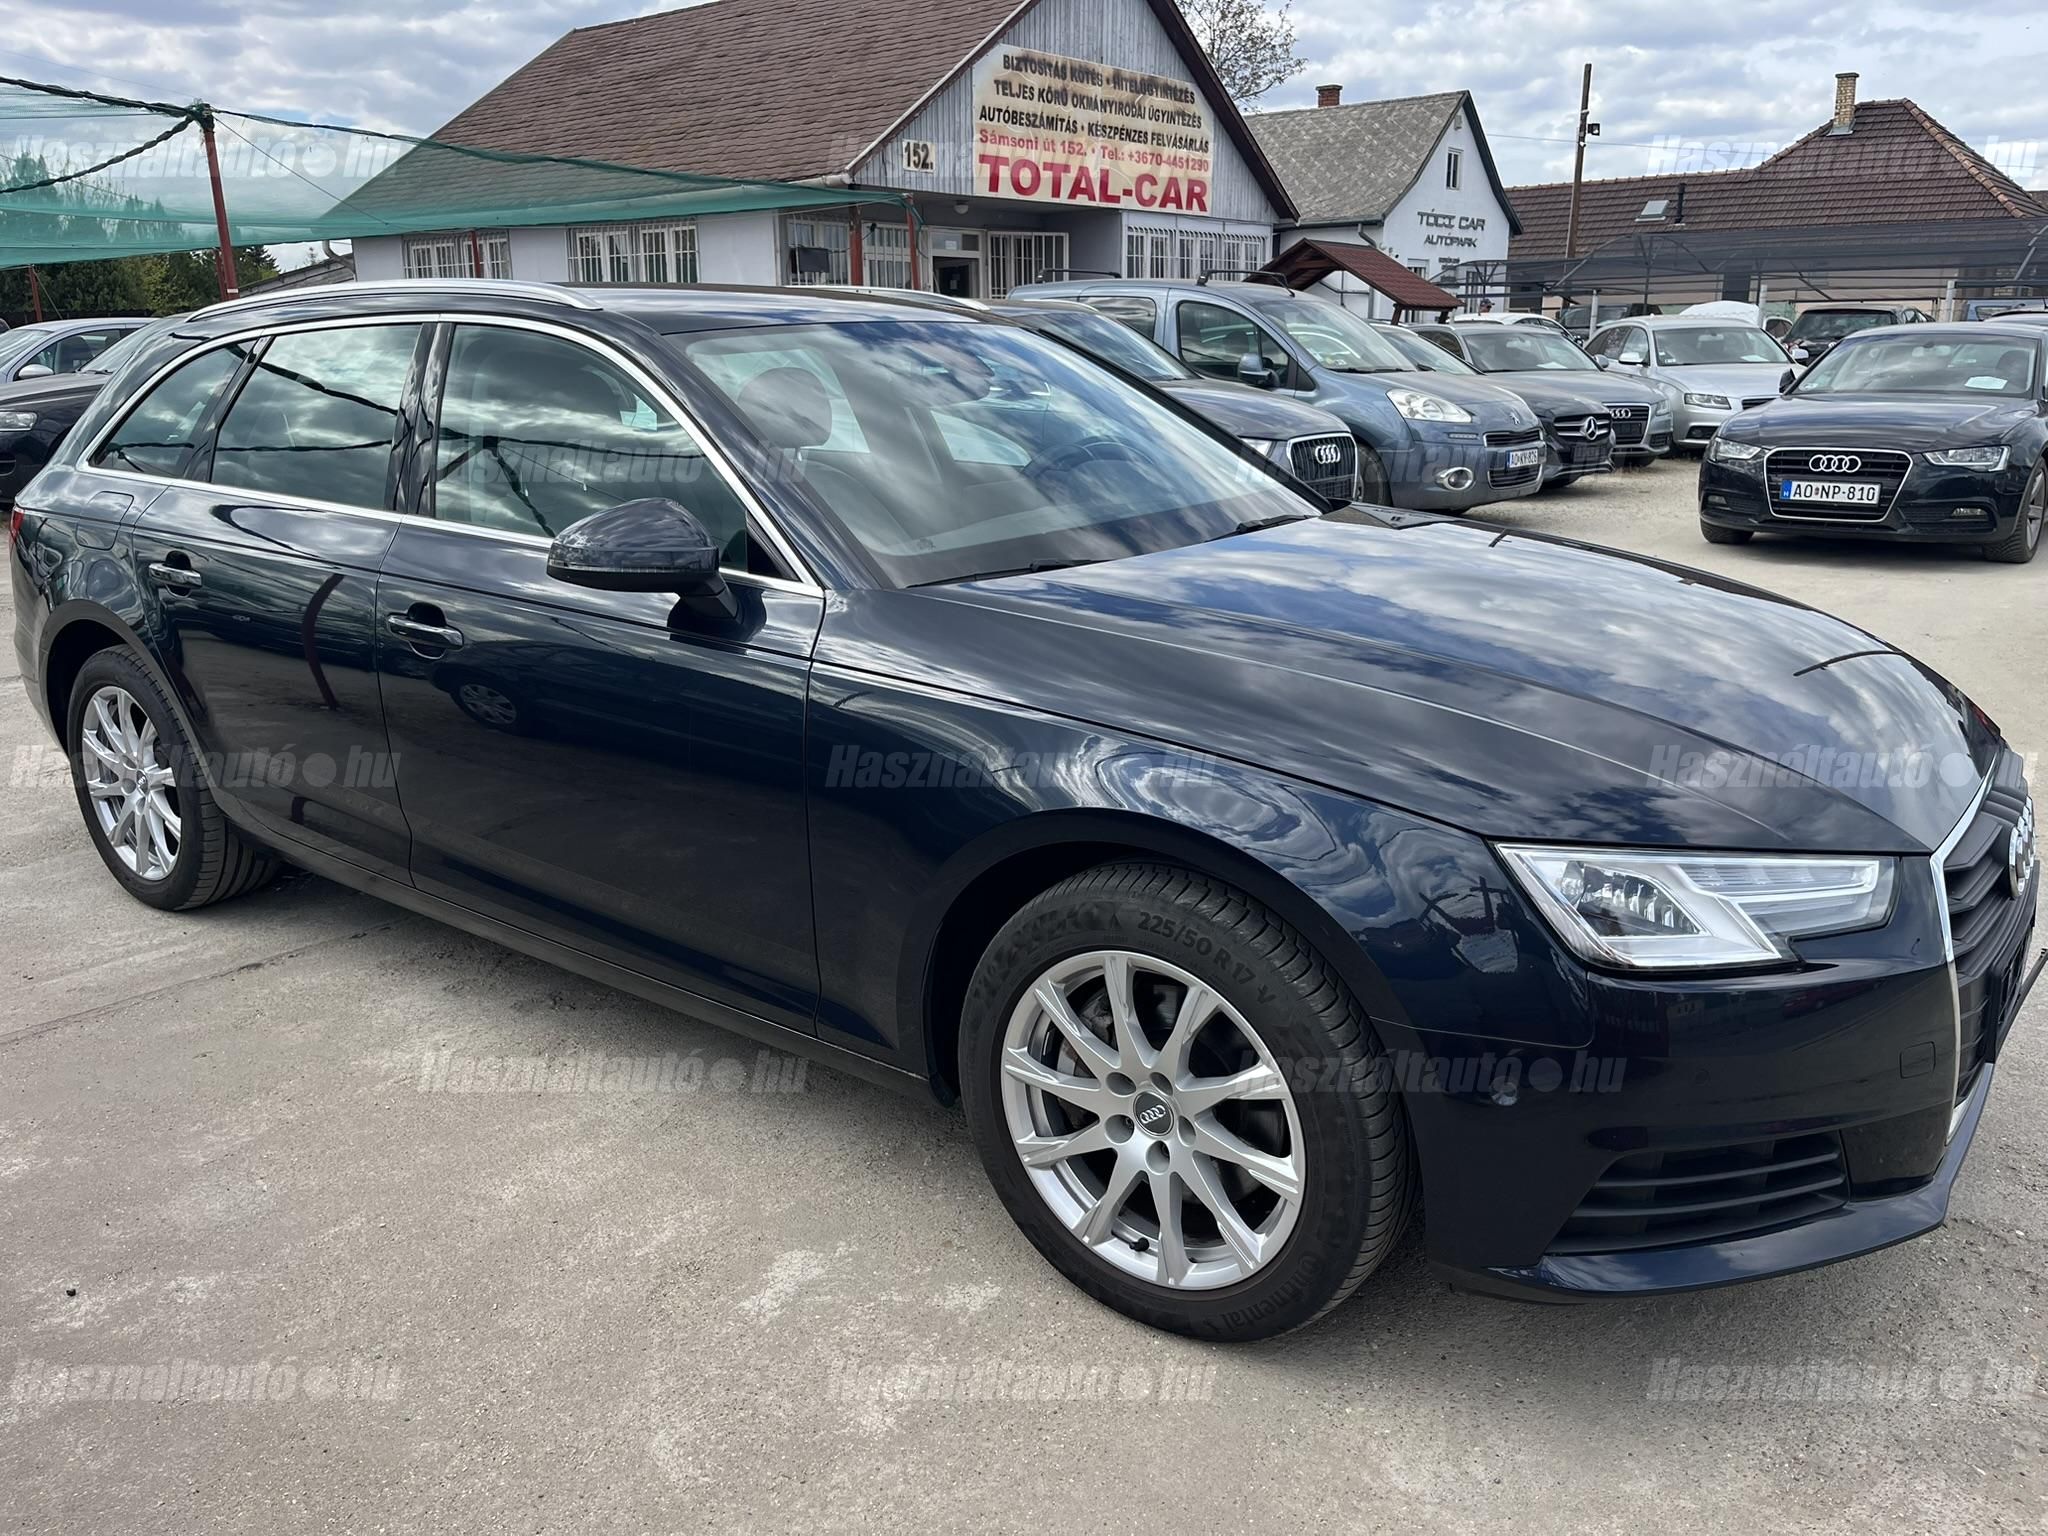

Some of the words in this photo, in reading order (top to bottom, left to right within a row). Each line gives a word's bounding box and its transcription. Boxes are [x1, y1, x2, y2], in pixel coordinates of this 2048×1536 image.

[994, 79, 1034, 102] TELJES
[1071, 92, 1145, 120] OKMÁNYIRODAI
[1148, 103, 1202, 129] ÜGYINTÉZÉS
[979, 104, 1078, 134] AUTÓBESZÁMÍTÁS
[1087, 120, 1148, 144] KÉSZPÉNZES
[1150, 131, 1209, 154] FELVÁSÁRLÁS
[979, 128, 1038, 150] Sámsoni
[1043, 138, 1056, 153] út
[1060, 140, 1087, 157] 152.
[1127, 151, 1209, 172] +3670-4451290
[979, 153, 1208, 212] TOTAL-CAR
[1424, 232, 1477, 248] AUTÓPARK
[1458, 216, 1486, 231] CAR
[1820, 485, 1876, 501] NP-810
[1137, 911, 1212, 956] 225/50
[1213, 948, 1232, 970] R
[1232, 962, 1257, 985] 17
